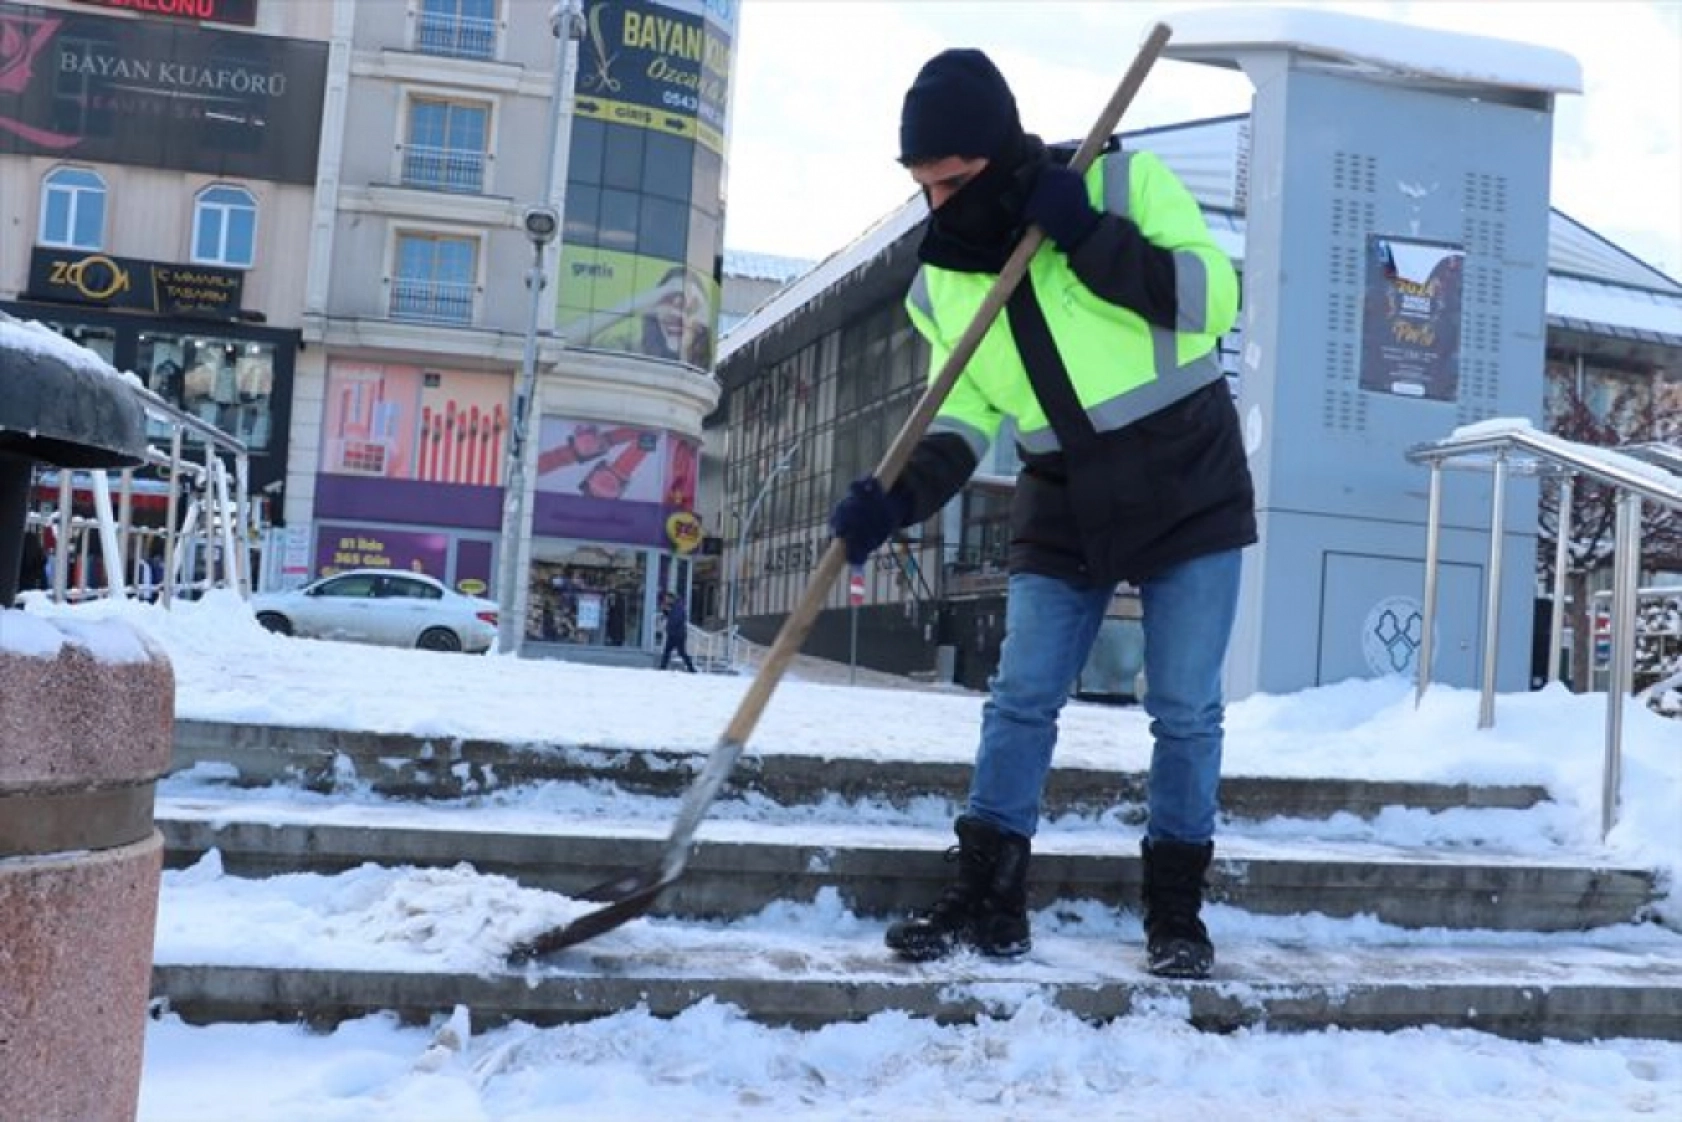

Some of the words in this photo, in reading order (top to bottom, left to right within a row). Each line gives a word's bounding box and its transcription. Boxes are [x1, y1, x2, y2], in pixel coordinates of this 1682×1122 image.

[112, 0, 215, 17] LONU
[622, 9, 703, 62] BAYAN
[60, 50, 150, 82] BAYAN
[157, 62, 288, 97] KUAFÖRÜ
